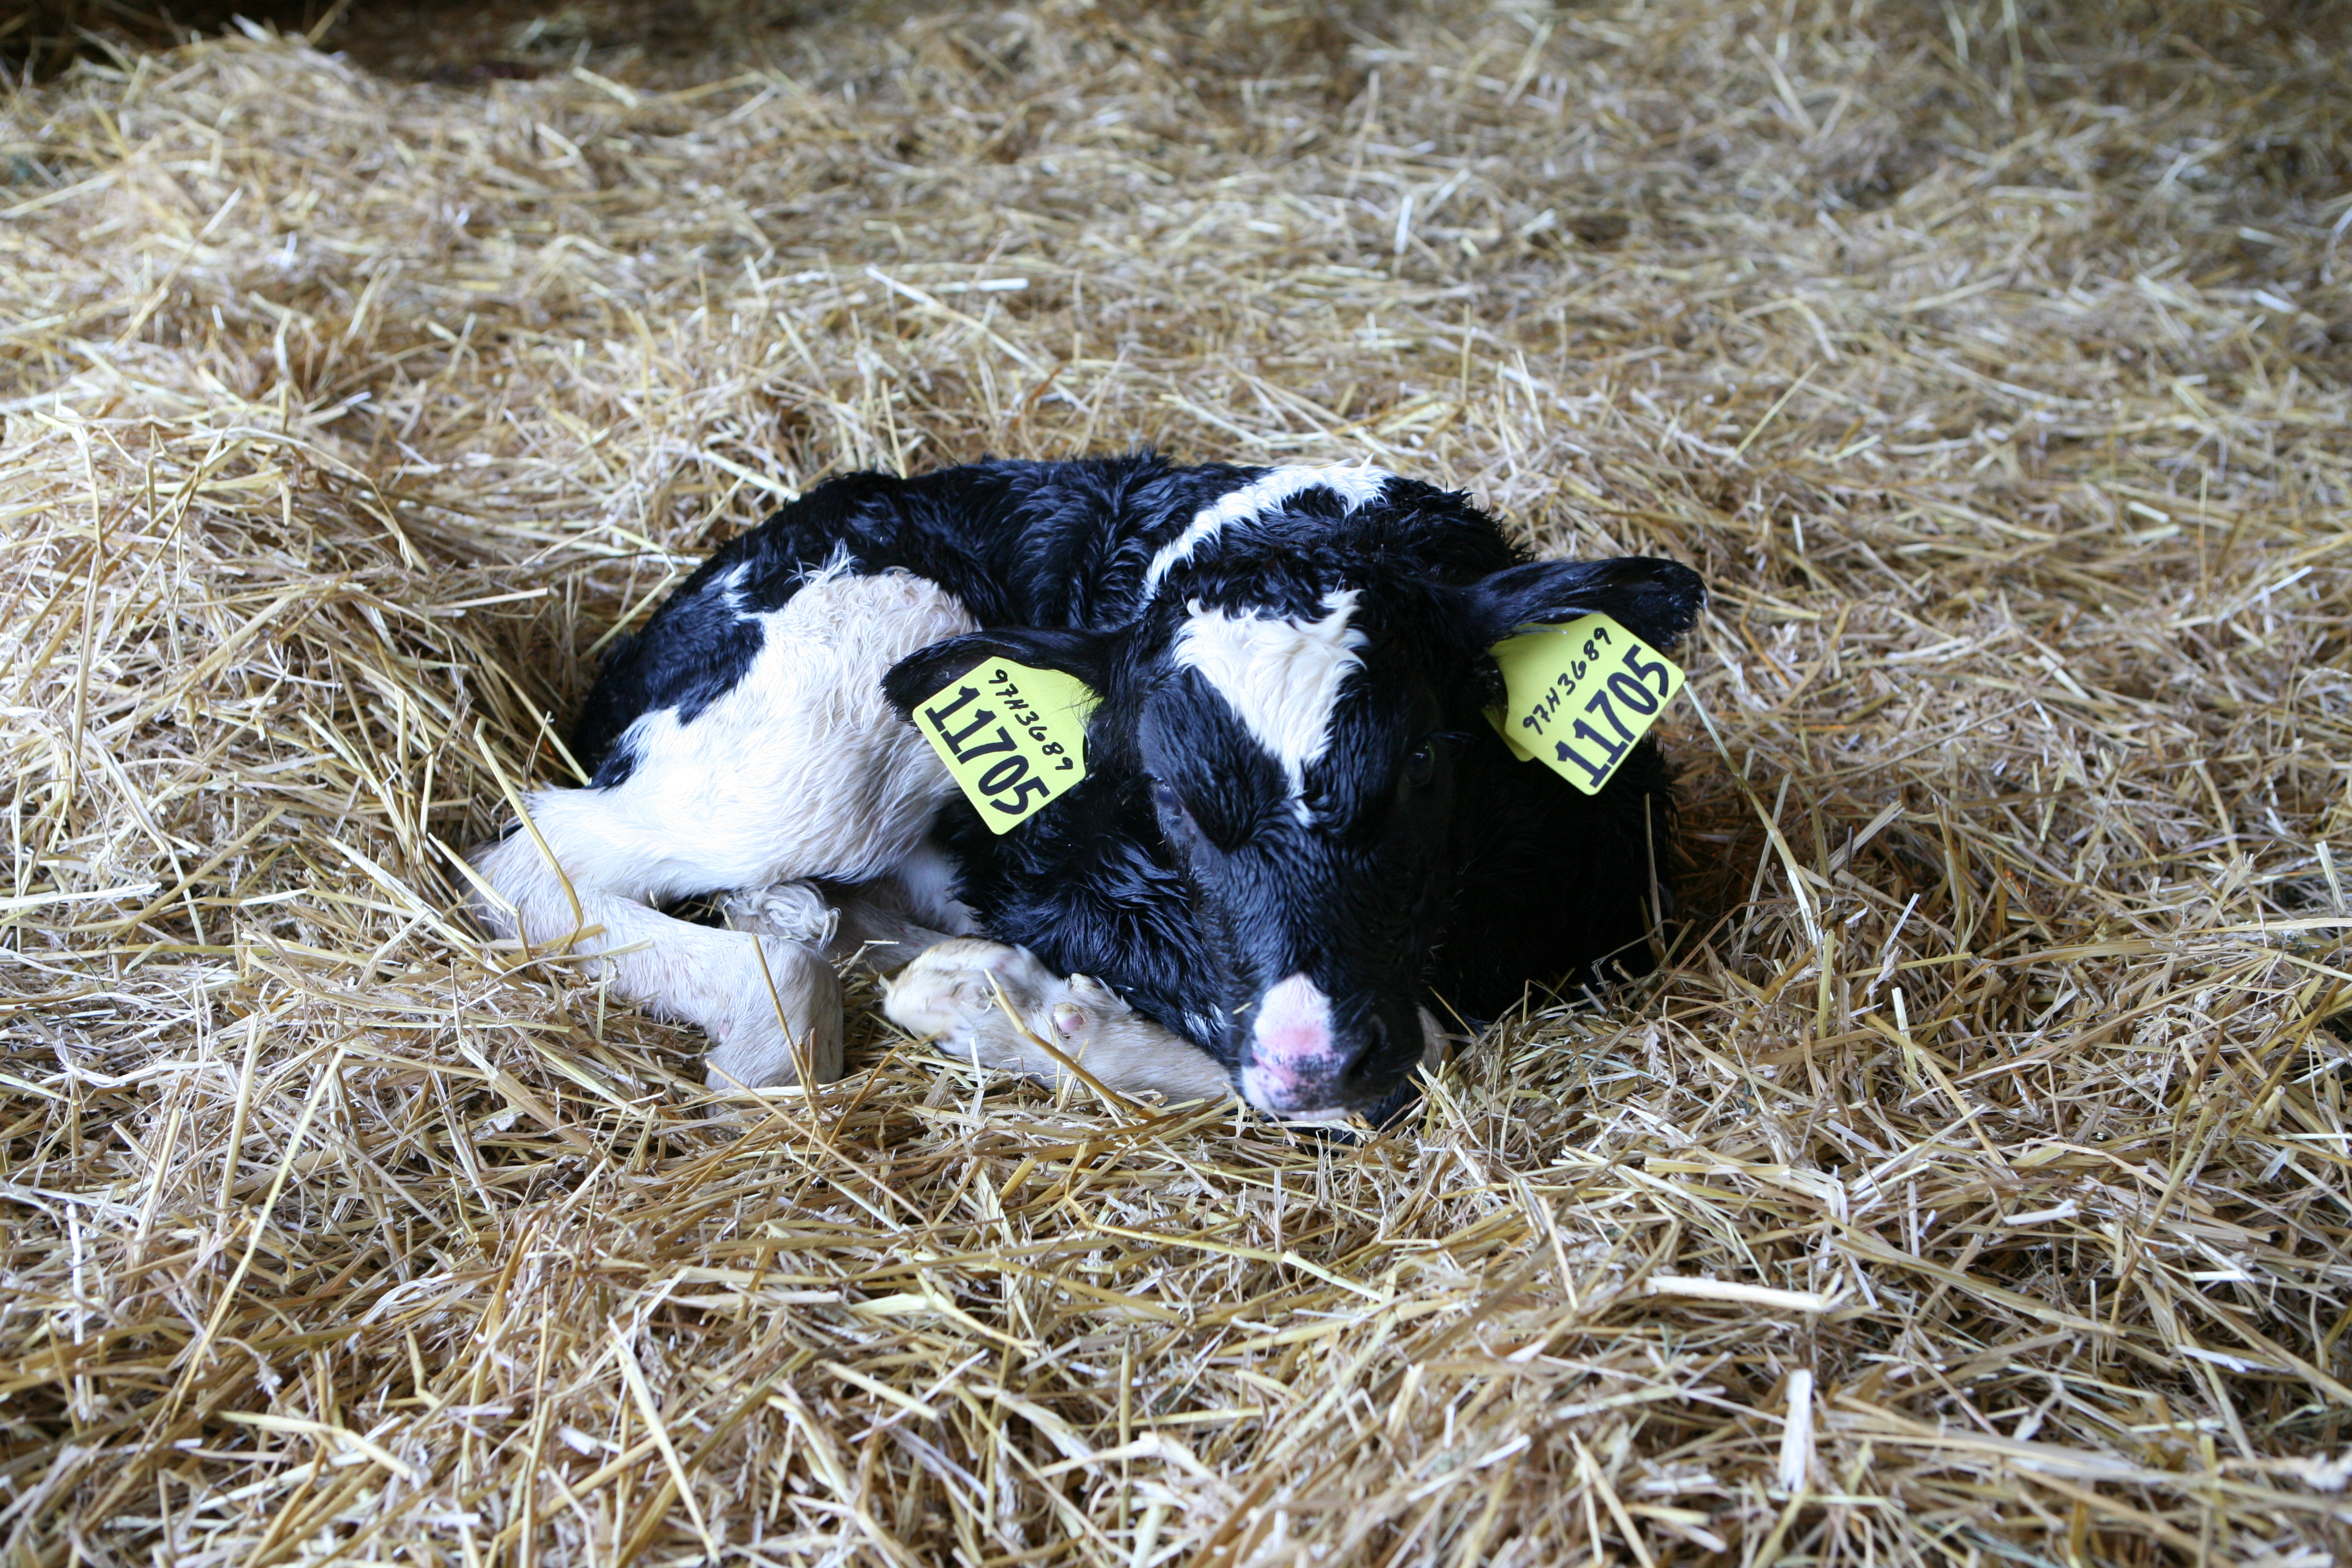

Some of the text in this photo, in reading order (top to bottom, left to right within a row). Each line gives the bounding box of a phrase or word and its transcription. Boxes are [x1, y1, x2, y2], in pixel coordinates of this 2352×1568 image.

[989, 669, 1073, 770] 97H3689
[1523, 627, 1612, 735] 97H3689
[1555, 644, 1669, 788] 11705
[925, 686, 1051, 815] 11705
